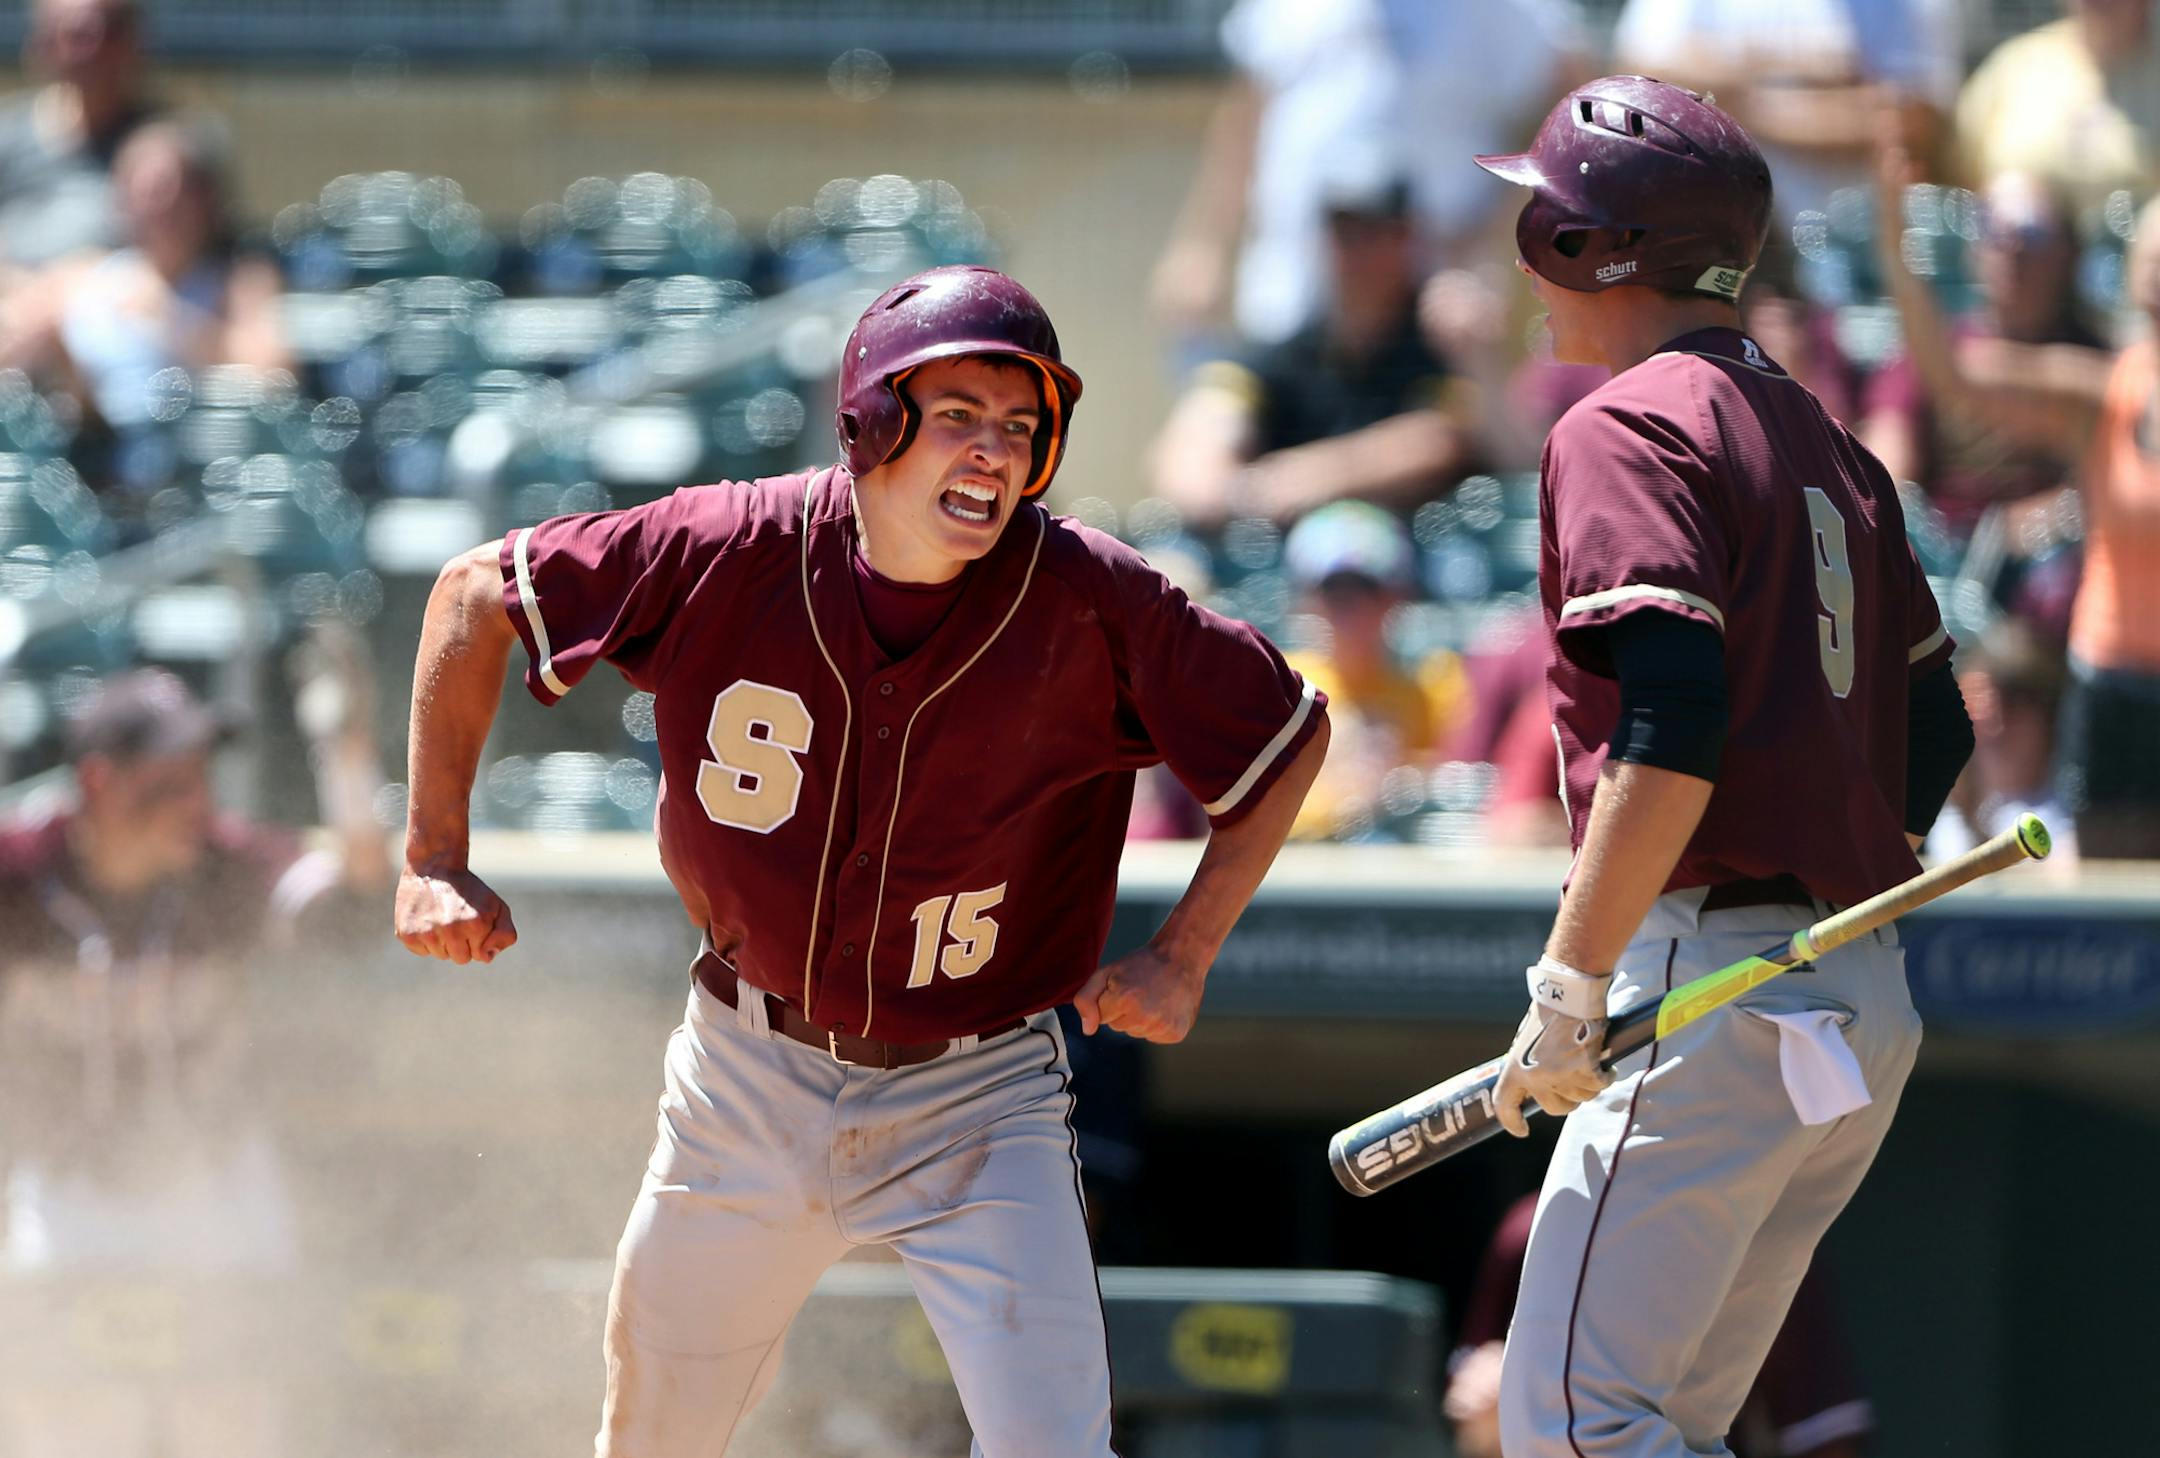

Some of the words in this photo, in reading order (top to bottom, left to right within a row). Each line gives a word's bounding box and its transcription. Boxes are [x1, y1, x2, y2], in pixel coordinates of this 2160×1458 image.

[1803, 486, 1855, 699] 9
[695, 678, 814, 835] S
[906, 880, 1008, 990] 15
